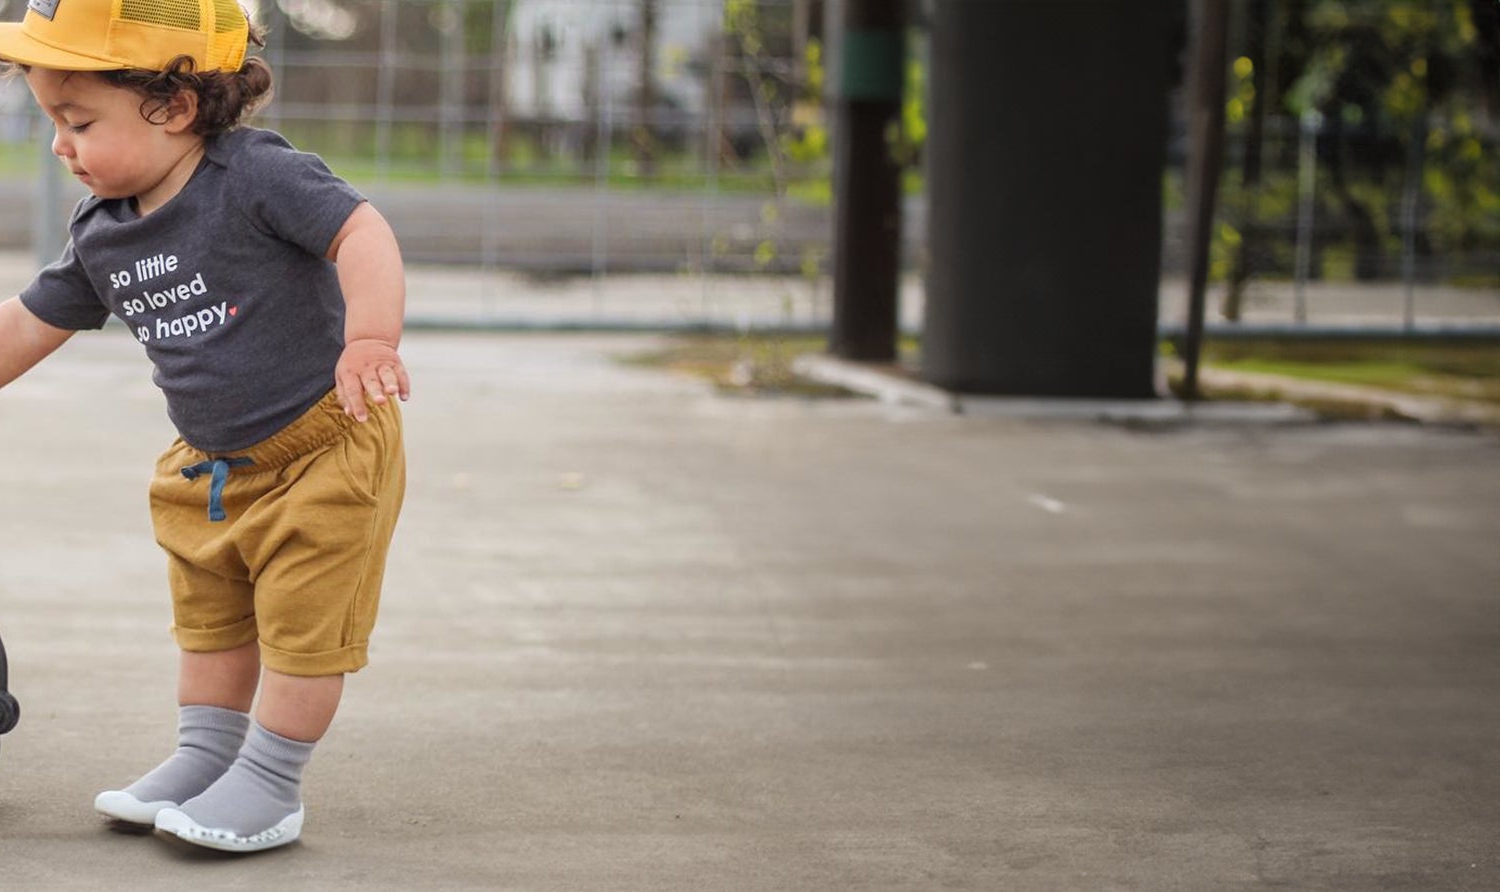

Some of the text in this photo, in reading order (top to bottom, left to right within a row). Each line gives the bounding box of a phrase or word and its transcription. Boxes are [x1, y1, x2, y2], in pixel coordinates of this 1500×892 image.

[109, 253, 178, 289] so little
[122, 272, 208, 316] so loved
[137, 301, 227, 343] so happy
